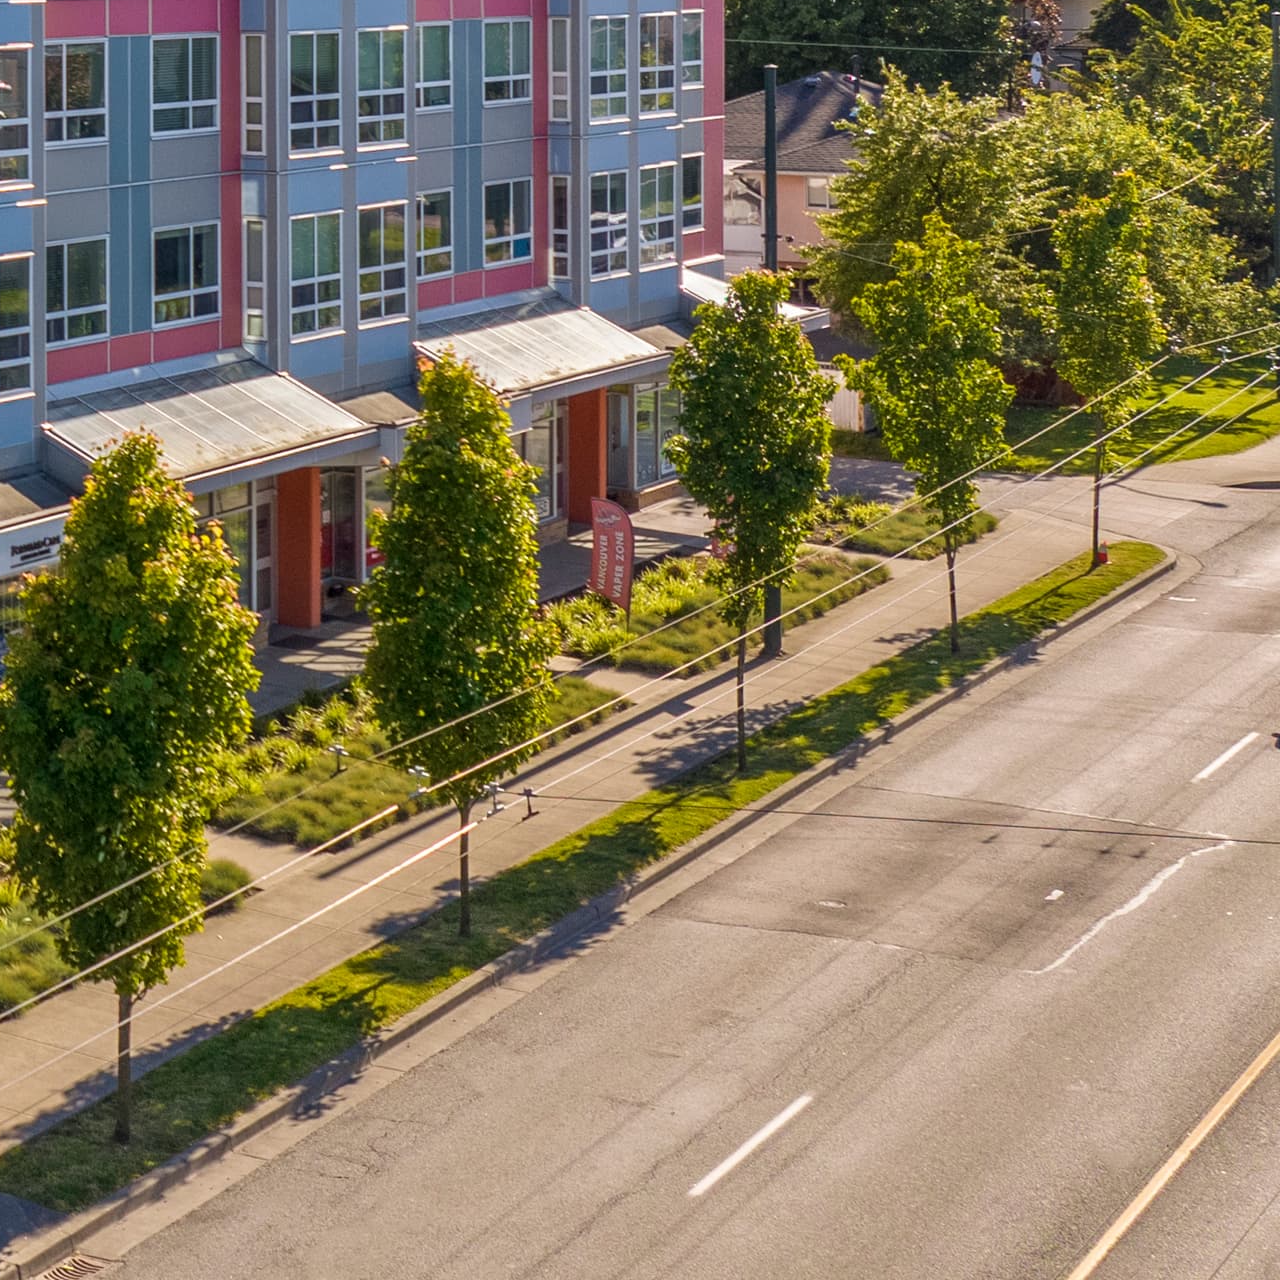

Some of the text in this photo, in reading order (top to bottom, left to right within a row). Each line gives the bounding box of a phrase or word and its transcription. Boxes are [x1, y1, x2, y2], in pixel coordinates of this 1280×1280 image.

[597, 535, 608, 589] VANCOUVER
[612, 531, 624, 598] VAPER ZONE
